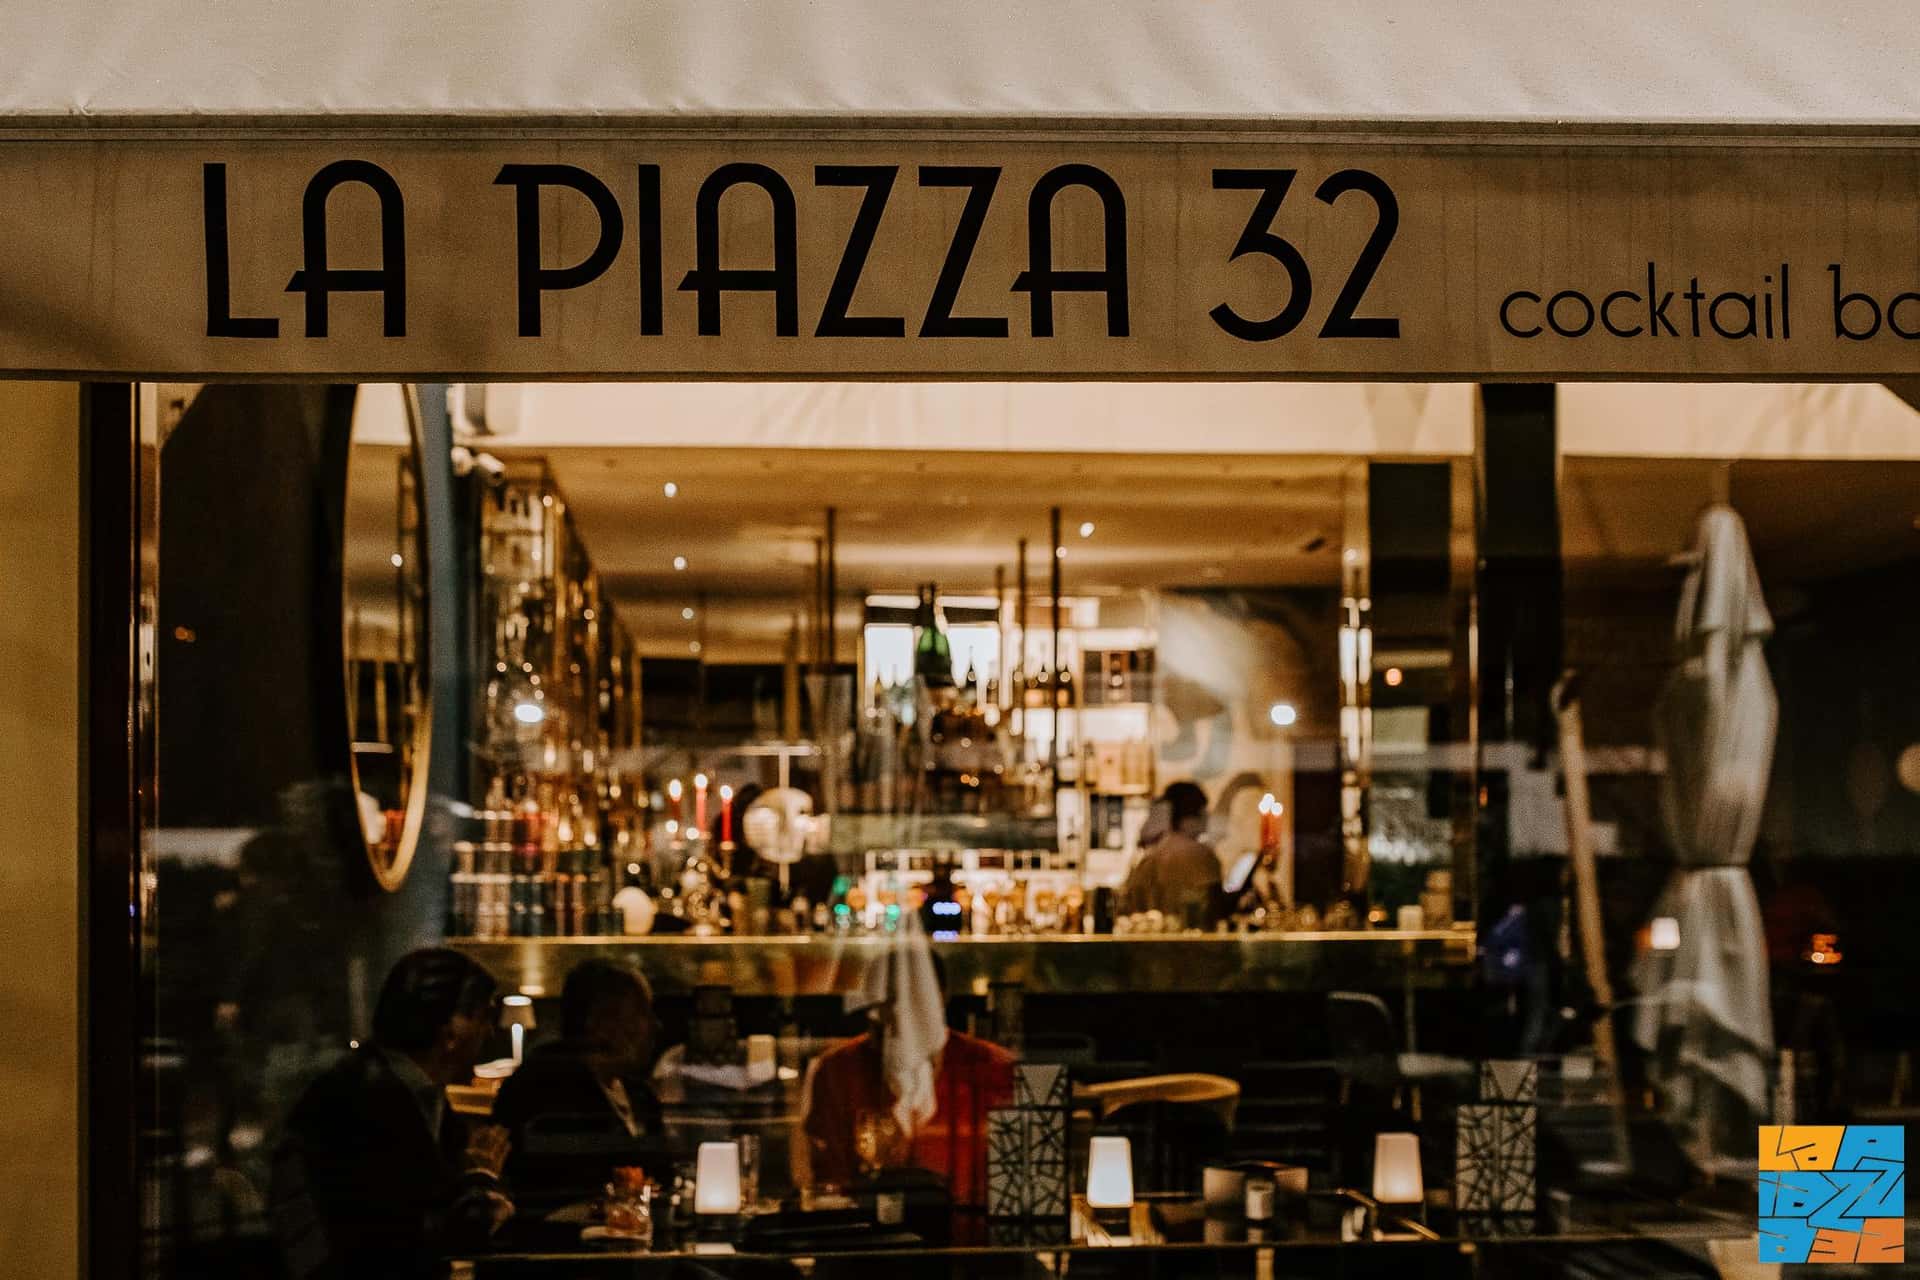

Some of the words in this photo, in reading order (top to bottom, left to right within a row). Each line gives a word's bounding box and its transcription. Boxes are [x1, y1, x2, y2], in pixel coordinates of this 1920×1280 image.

[203, 159, 407, 338] LA
[492, 162, 1130, 338] PIAZZA
[1209, 168, 1400, 342] 32
[1499, 261, 1790, 340] cocktail
